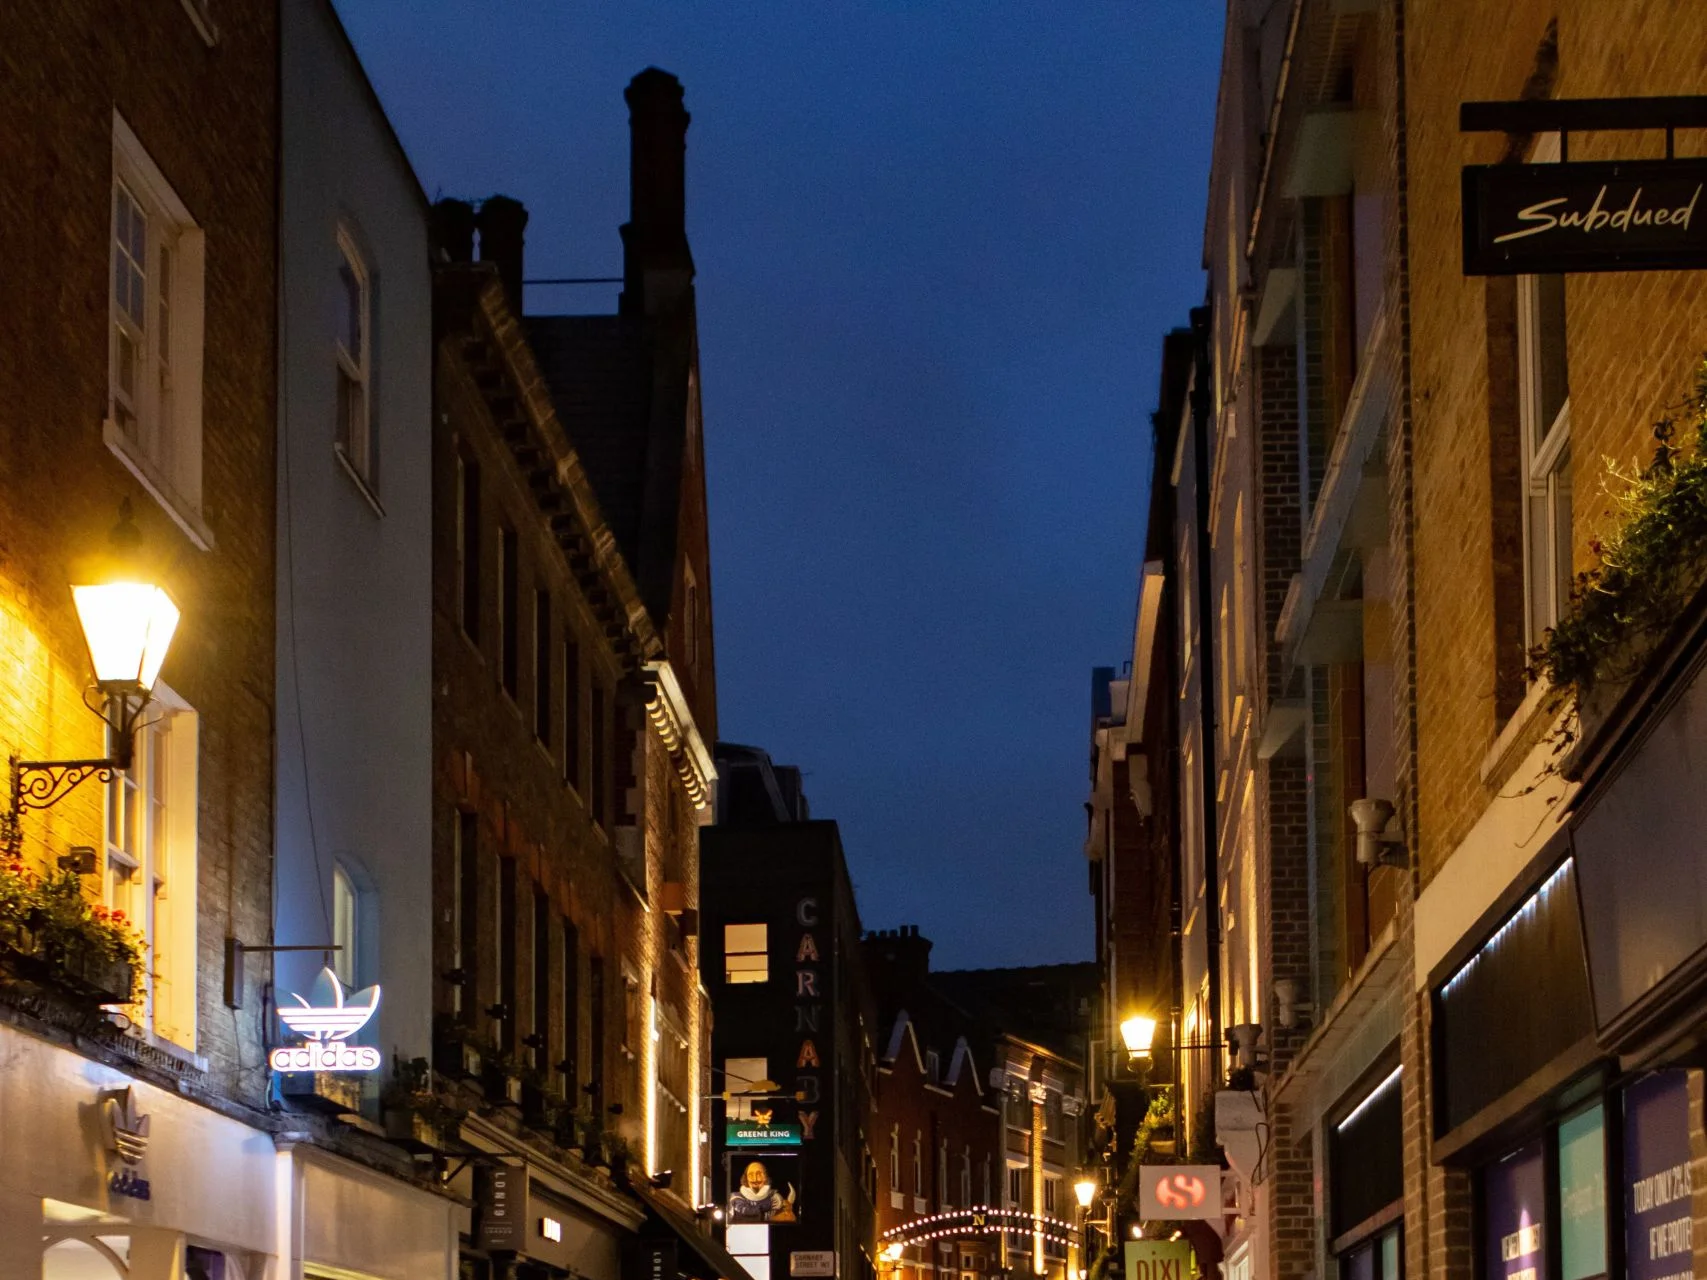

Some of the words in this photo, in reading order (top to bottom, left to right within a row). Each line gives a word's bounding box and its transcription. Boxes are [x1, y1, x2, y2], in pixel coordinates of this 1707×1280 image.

[1493, 183, 1704, 243] Subdued
[795, 898, 822, 1140] CARNABY
[272, 1043, 377, 1069] adidas
[736, 1130, 768, 1138] GREENE
[769, 1130, 791, 1138] KING
[1633, 1175, 1654, 1214] TODAY
[1654, 1168, 1672, 1208] ONLY
